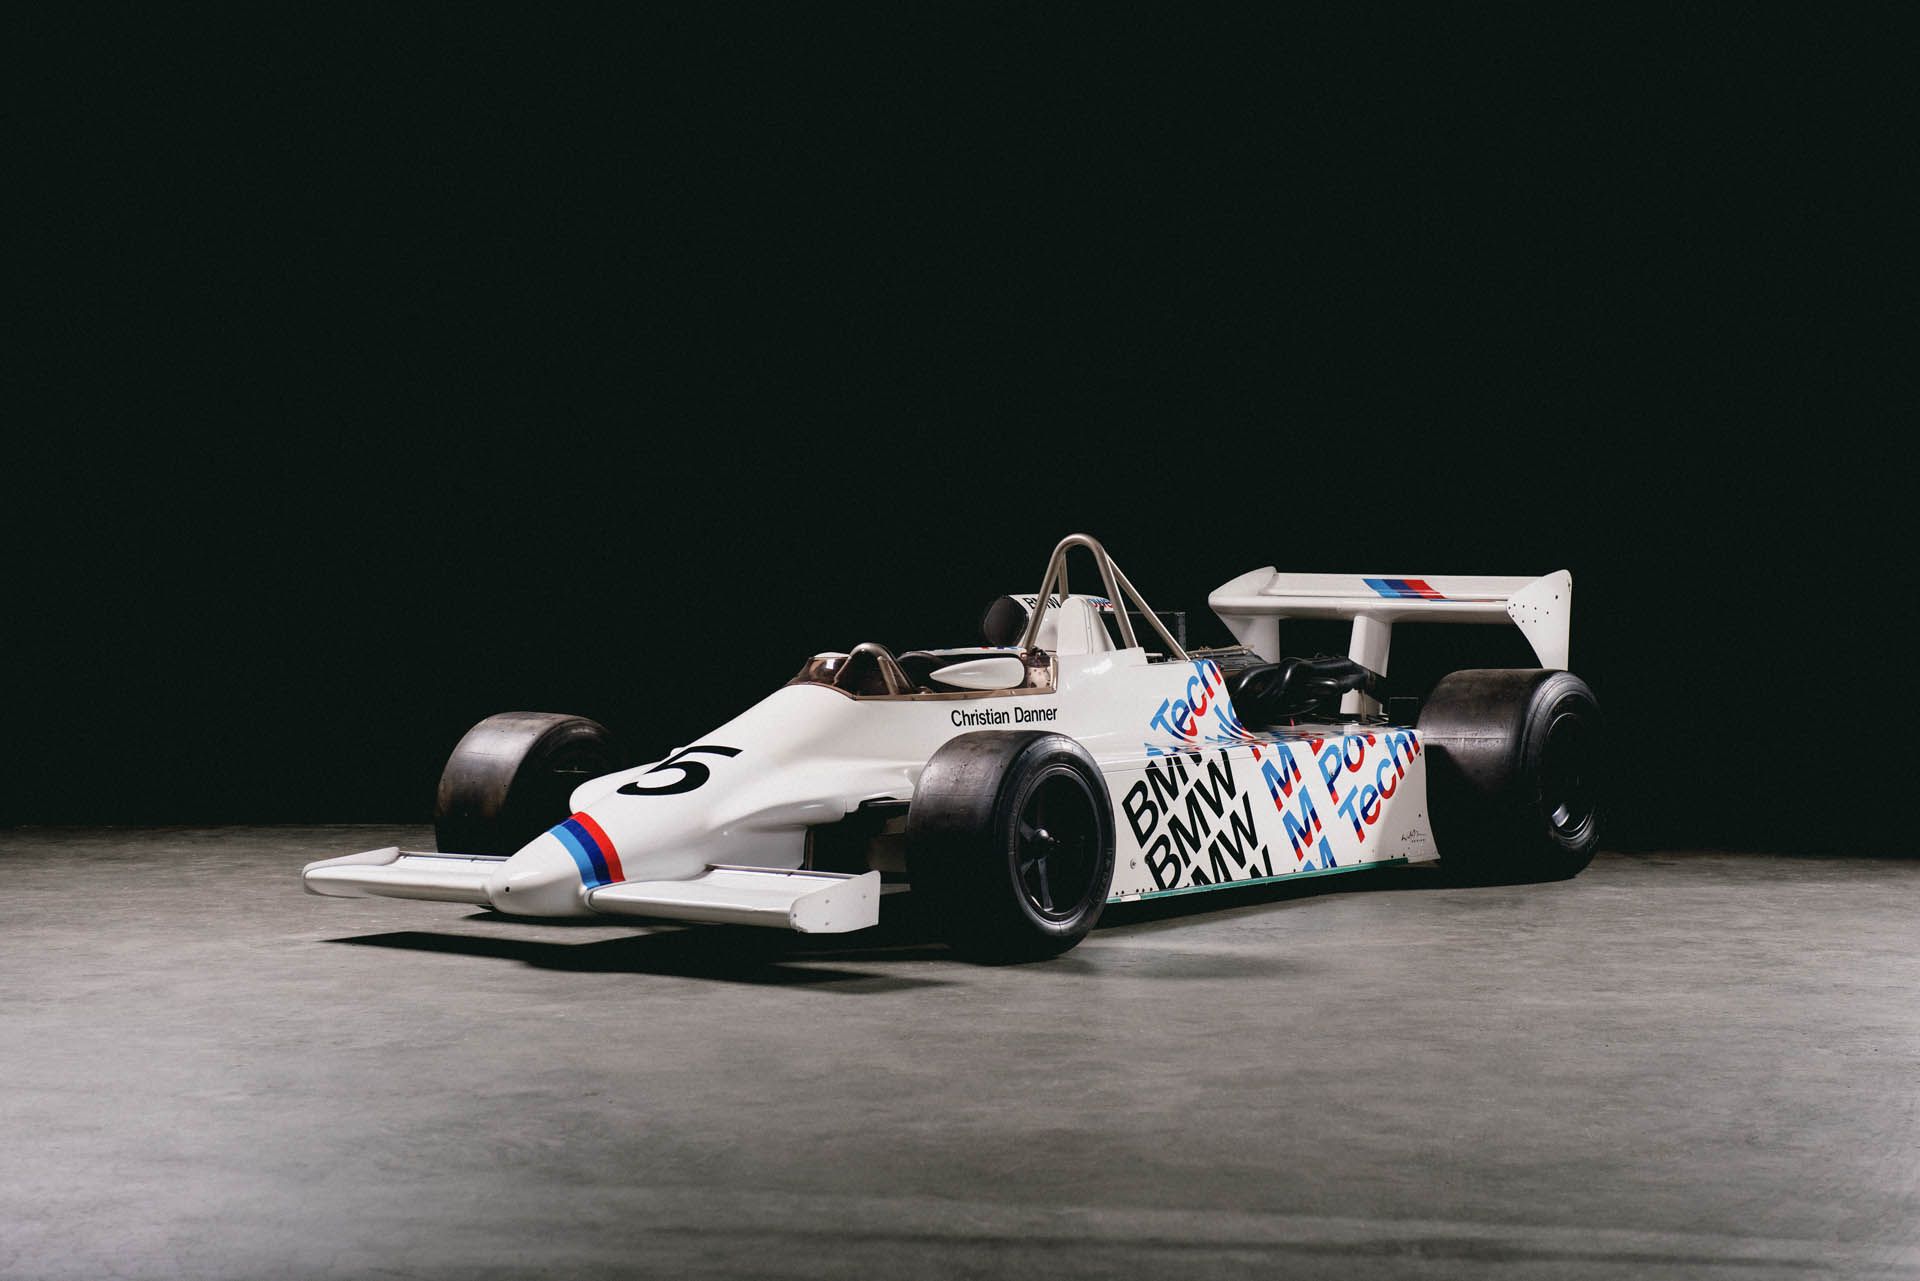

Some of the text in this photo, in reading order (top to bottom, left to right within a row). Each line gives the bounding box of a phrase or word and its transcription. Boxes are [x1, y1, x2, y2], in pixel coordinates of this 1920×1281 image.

[1022, 597, 1061, 609] BW
[951, 706, 1058, 727] Christian Danner
[616, 745, 744, 796] 5
[1122, 752, 1202, 848] BM
[1261, 741, 1301, 811] M
[1145, 749, 1236, 891] BMW
[1283, 784, 1322, 861] M
